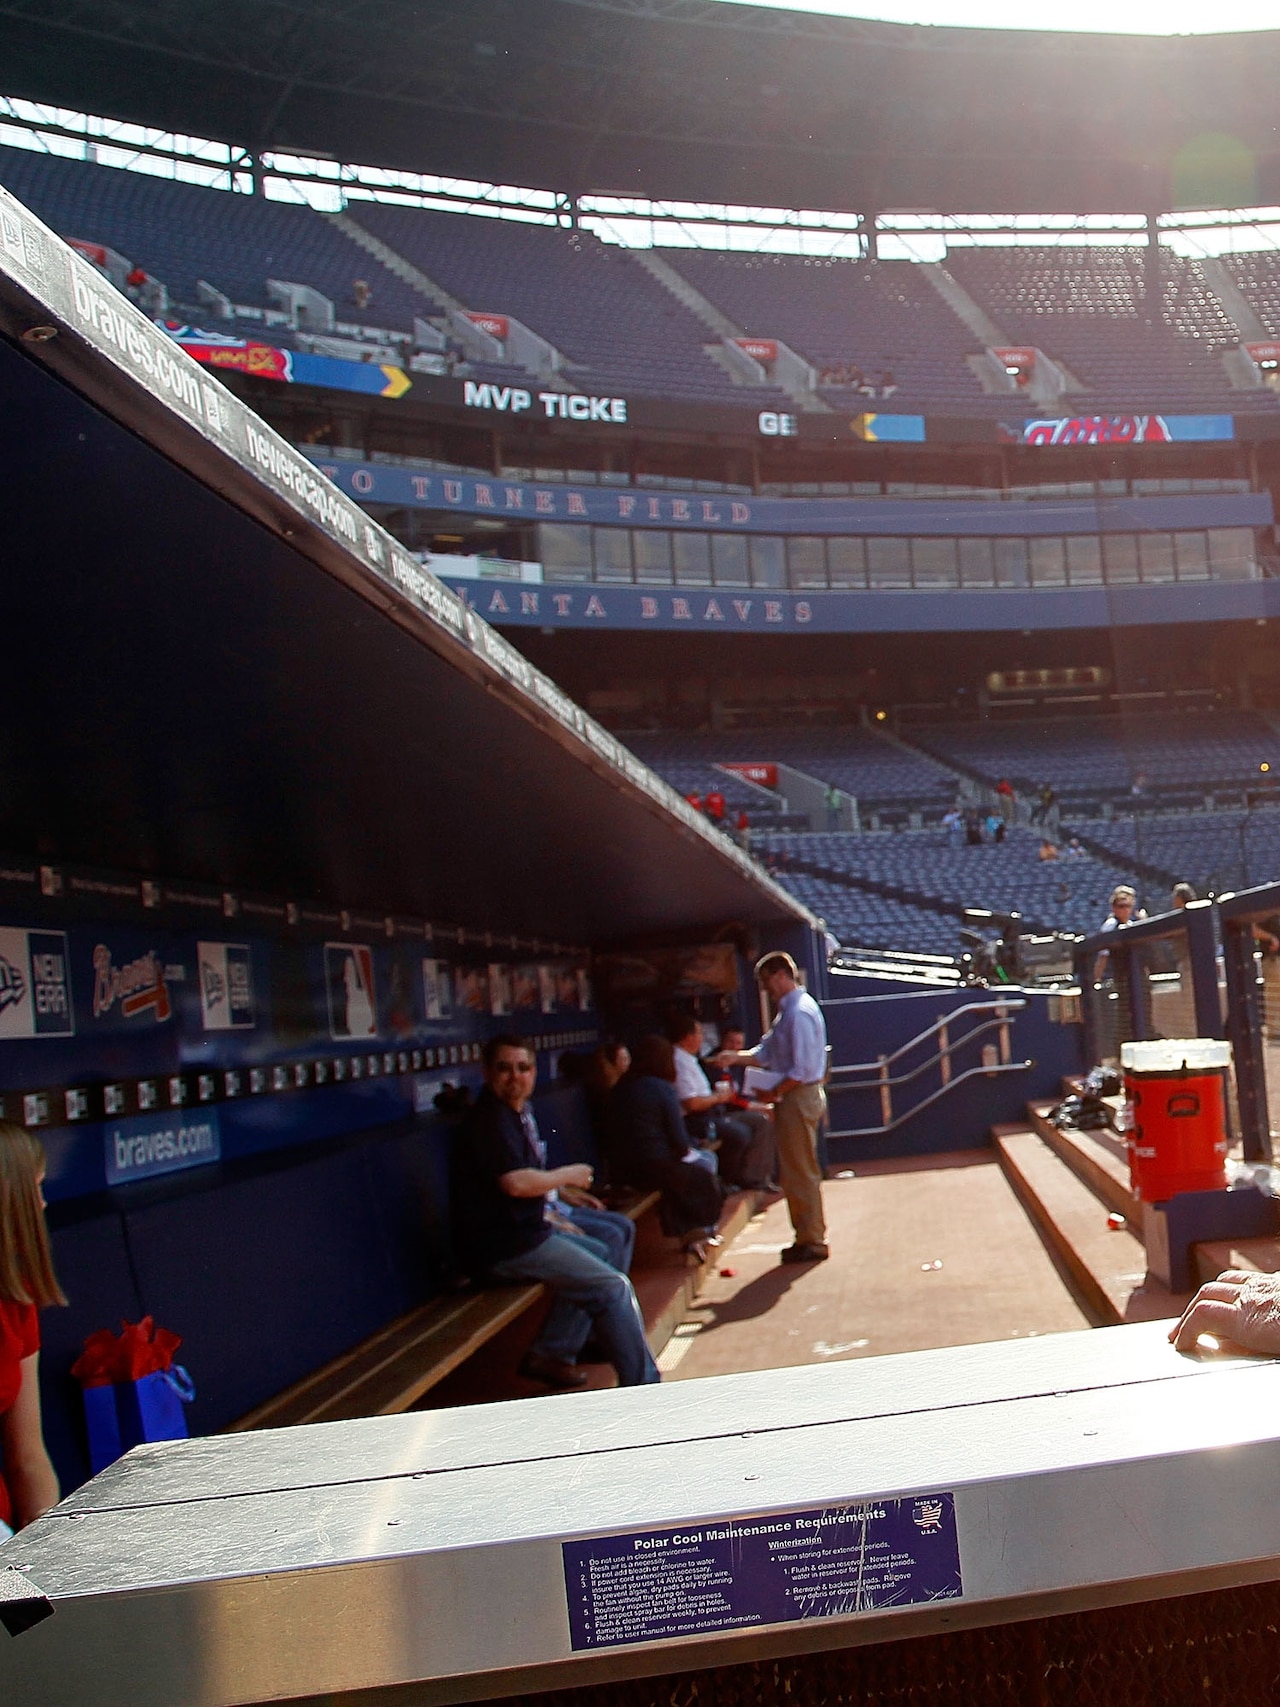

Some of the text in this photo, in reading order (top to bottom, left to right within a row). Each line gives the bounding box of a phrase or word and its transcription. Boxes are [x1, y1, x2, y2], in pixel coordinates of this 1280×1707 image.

[69, 256, 203, 415] braves.com
[246, 424, 357, 543] neweracap.com
[464, 381, 627, 423] MVP TICKE
[411, 476, 588, 516] TURNER
[618, 494, 750, 525] FIELD
[640, 596, 813, 623] BRAVES
[114, 1124, 213, 1170] braves.com
[634, 1509, 886, 1550] Polar Cool Maintenance Requirements
[768, 1537, 822, 1550] Winterization
[778, 1553, 798, 1561] When
[799, 1550, 820, 1559] storing
[864, 1541, 890, 1551] periods.
[634, 1551, 656, 1560] closed
[628, 1566, 651, 1575] bleach
[661, 1562, 686, 1570] chlorine
[791, 1566, 810, 1574] Flush
[836, 1559, 866, 1567] reservor.
[820, 1568, 847, 1577] reservoir
[860, 1562, 889, 1571] xtended
[598, 1578, 618, 1587] power
[636, 1572, 668, 1580] extension
[602, 1590, 627, 1599] prevent
[663, 1583, 679, 1592] pads
[708, 1577, 732, 1585] running
[628, 1582, 640, 1590] you
[694, 1572, 713, 1580] larger
[793, 1585, 820, 1594] Remove
[837, 1587, 864, 1596] deposs
[594, 1605, 625, 1614] Routinely
[627, 1601, 650, 1610] inspect
[688, 1592, 722, 1601] looseness
[618, 1596, 642, 1604] without
[595, 1620, 614, 1628] Flush
[642, 1613, 670, 1621] reservoir
[706, 1604, 731, 1614] prevent
[609, 1610, 633, 1619] inspect
[634, 1608, 653, 1616] spray
[677, 1601, 698, 1609] debris
[596, 1626, 623, 1634] damage
[597, 1634, 615, 1642] Refer
[641, 1627, 666, 1635] manual
[696, 1618, 722, 1628] detailed
